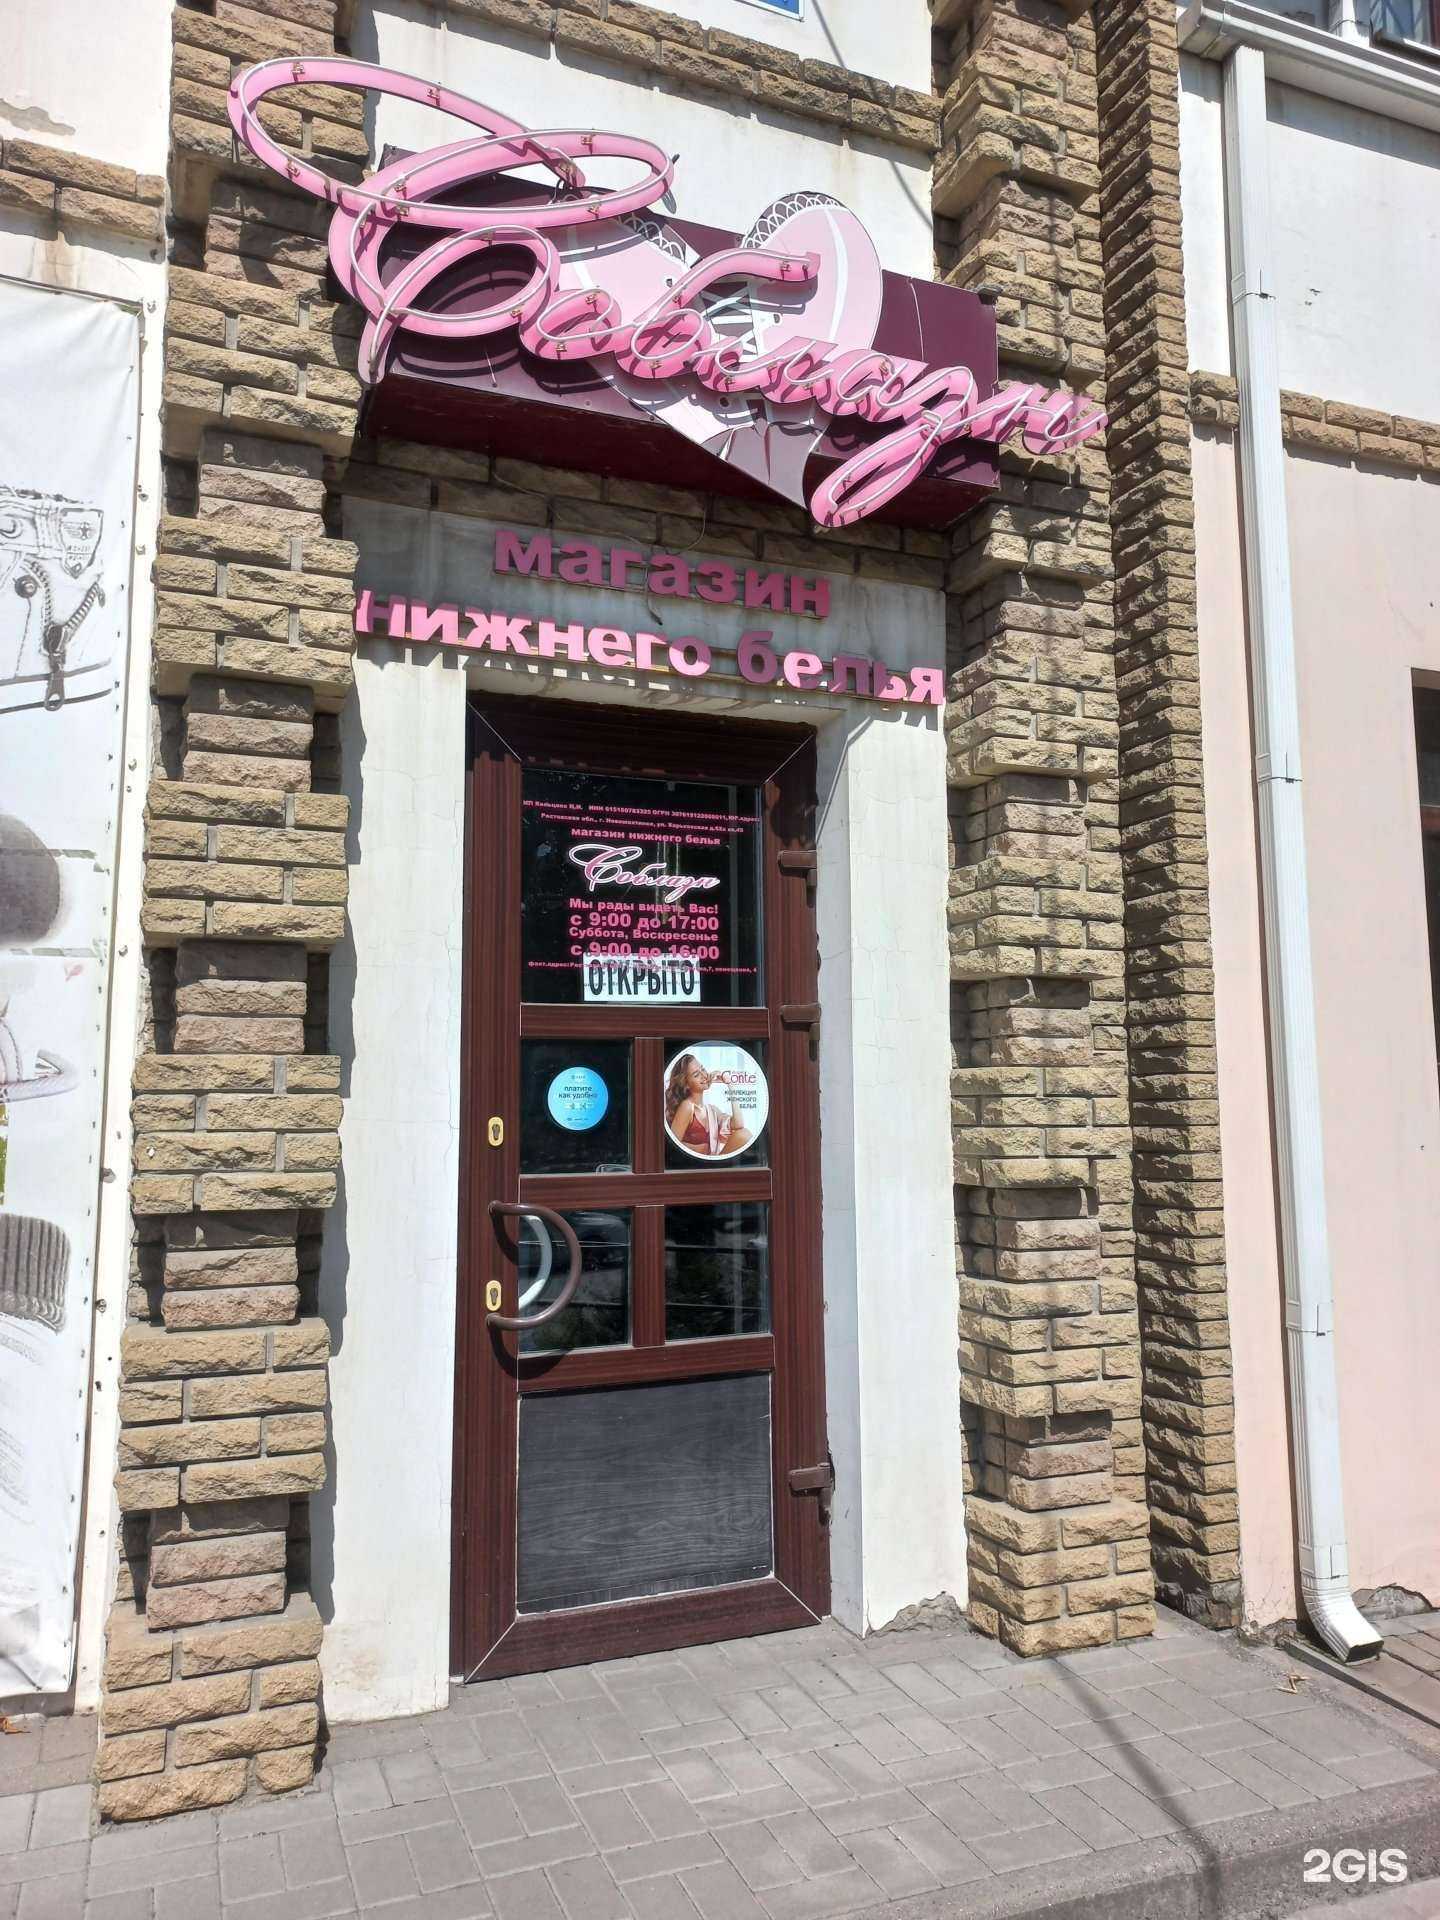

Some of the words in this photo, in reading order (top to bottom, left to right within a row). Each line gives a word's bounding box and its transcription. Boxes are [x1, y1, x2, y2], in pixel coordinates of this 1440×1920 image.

[228, 56, 1108, 527] Соблазн
[356, 590, 712, 677] нижнего
[737, 631, 946, 706] белья
[571, 828, 625, 839] магазин
[629, 831, 682, 843] нижнего
[685, 834, 721, 845] белья
[569, 844, 721, 903] Соблазн
[569, 898, 593, 909] Мы
[597, 901, 634, 912] рады
[638, 904, 684, 914] видеть
[689, 904, 719, 915] Вас!
[570, 914, 582, 926] с
[589, 912, 631, 927] 9:00
[637, 917, 661, 930] до
[669, 915, 719, 931] 17:00
[569, 927, 629, 940] Суббота,
[633, 929, 719, 942] Воскресенье
[570, 945, 583, 956] с
[589, 942, 631, 958] 9:00
[638, 946, 661, 958] до
[669, 944, 720, 959] 16:00
[588, 959, 695, 995] ОТКРЫТО
[722, 1070, 757, 1085] Conte
